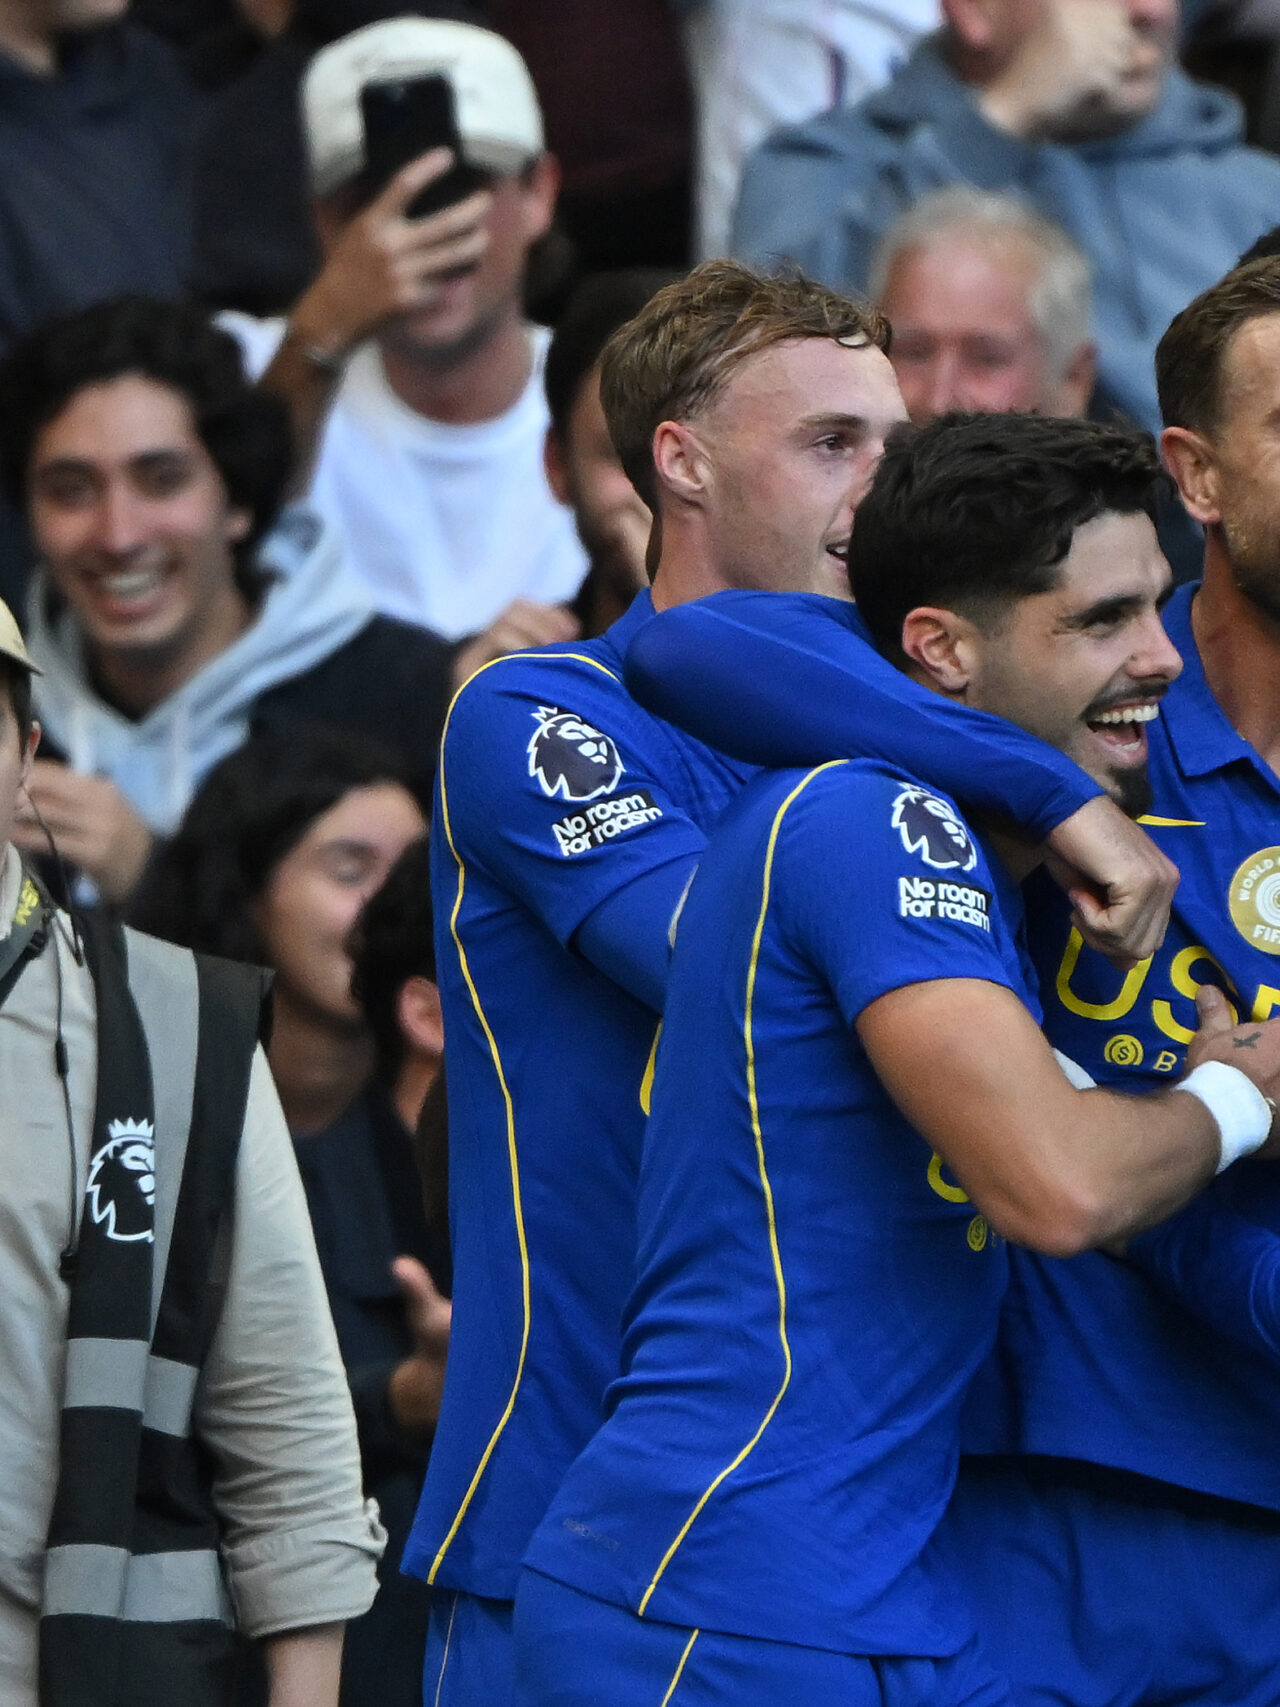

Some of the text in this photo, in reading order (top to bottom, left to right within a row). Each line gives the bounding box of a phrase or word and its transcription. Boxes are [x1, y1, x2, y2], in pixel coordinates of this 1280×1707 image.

[552, 795, 647, 844] No room
[560, 807, 664, 856] for racism
[899, 877, 986, 911] No room
[1239, 858, 1275, 901] WORLD
[900, 896, 990, 933] for racism
